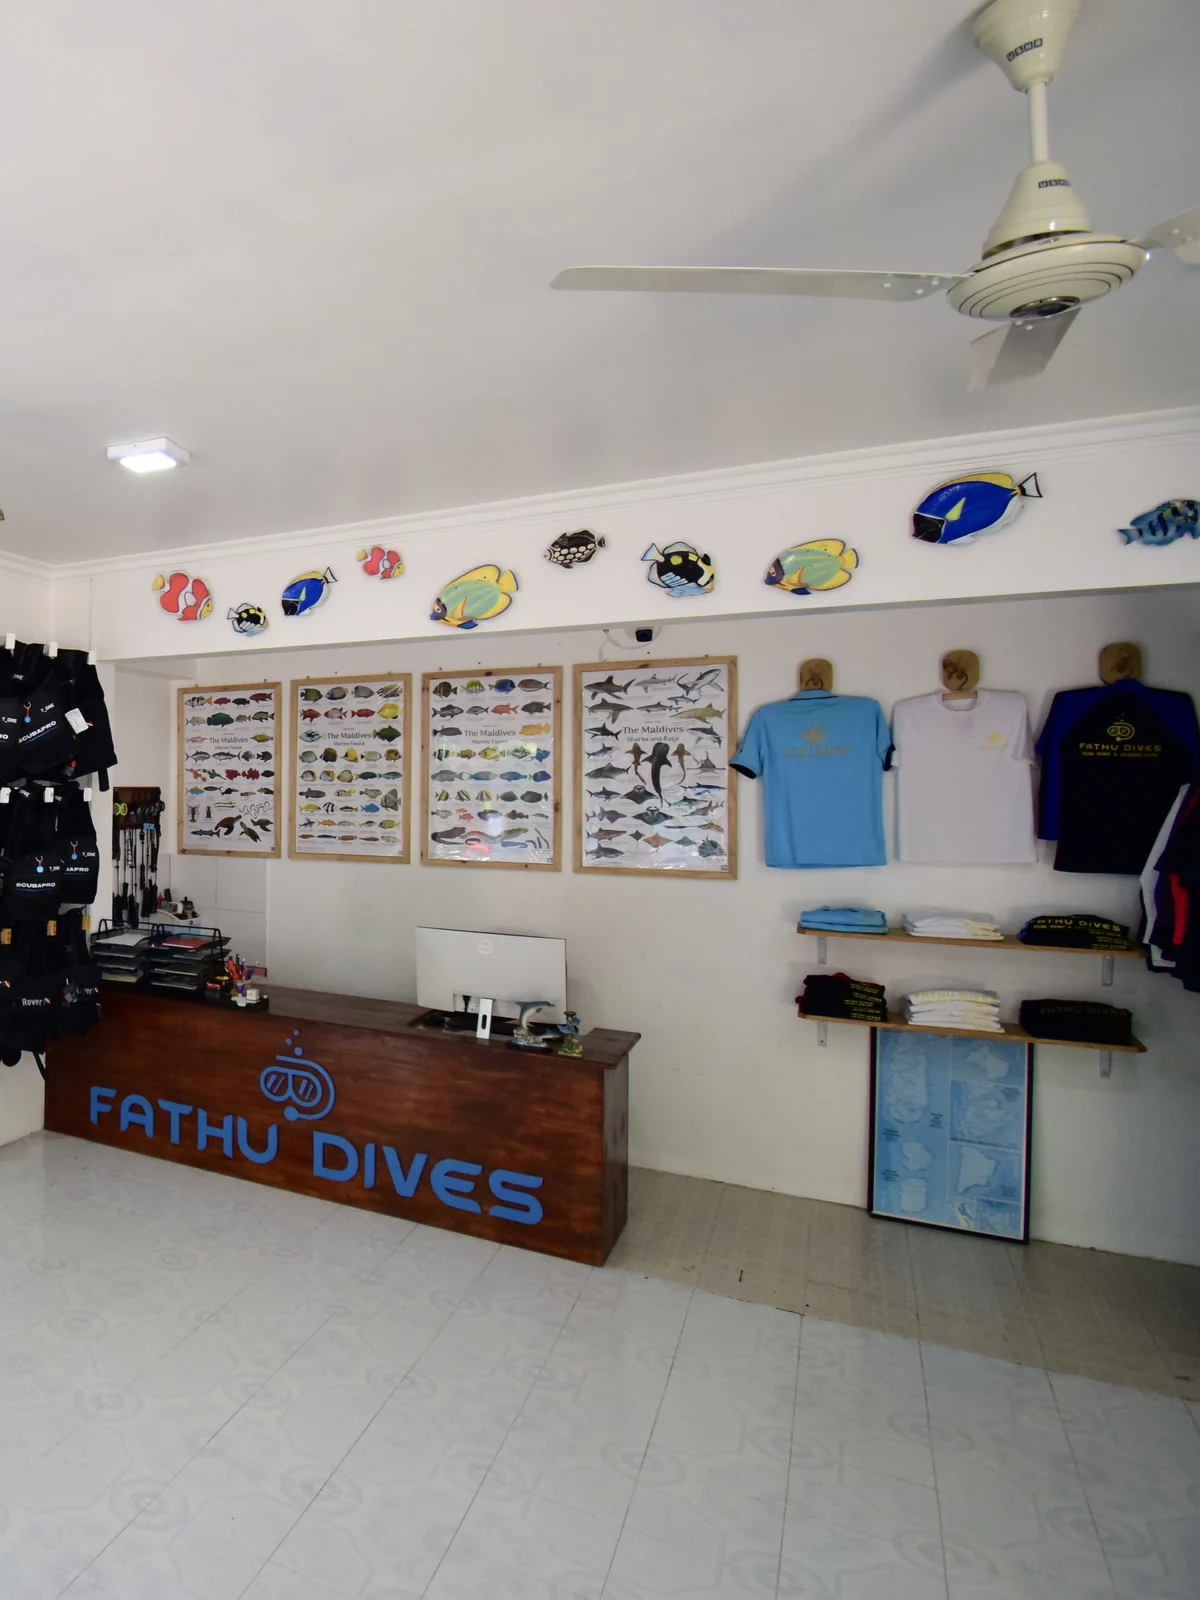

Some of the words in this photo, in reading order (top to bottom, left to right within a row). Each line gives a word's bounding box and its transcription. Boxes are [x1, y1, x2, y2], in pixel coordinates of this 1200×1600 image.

[623, 726, 639, 734] The
[642, 726, 684, 734] Maldives
[1079, 742, 1118, 751] FATHU
[1124, 744, 1162, 752] DIVES
[1079, 920, 1121, 932] DIVES
[22, 998, 43, 1006] Rover
[90, 1086, 278, 1164] FATHU
[313, 1130, 544, 1226] DIVES
